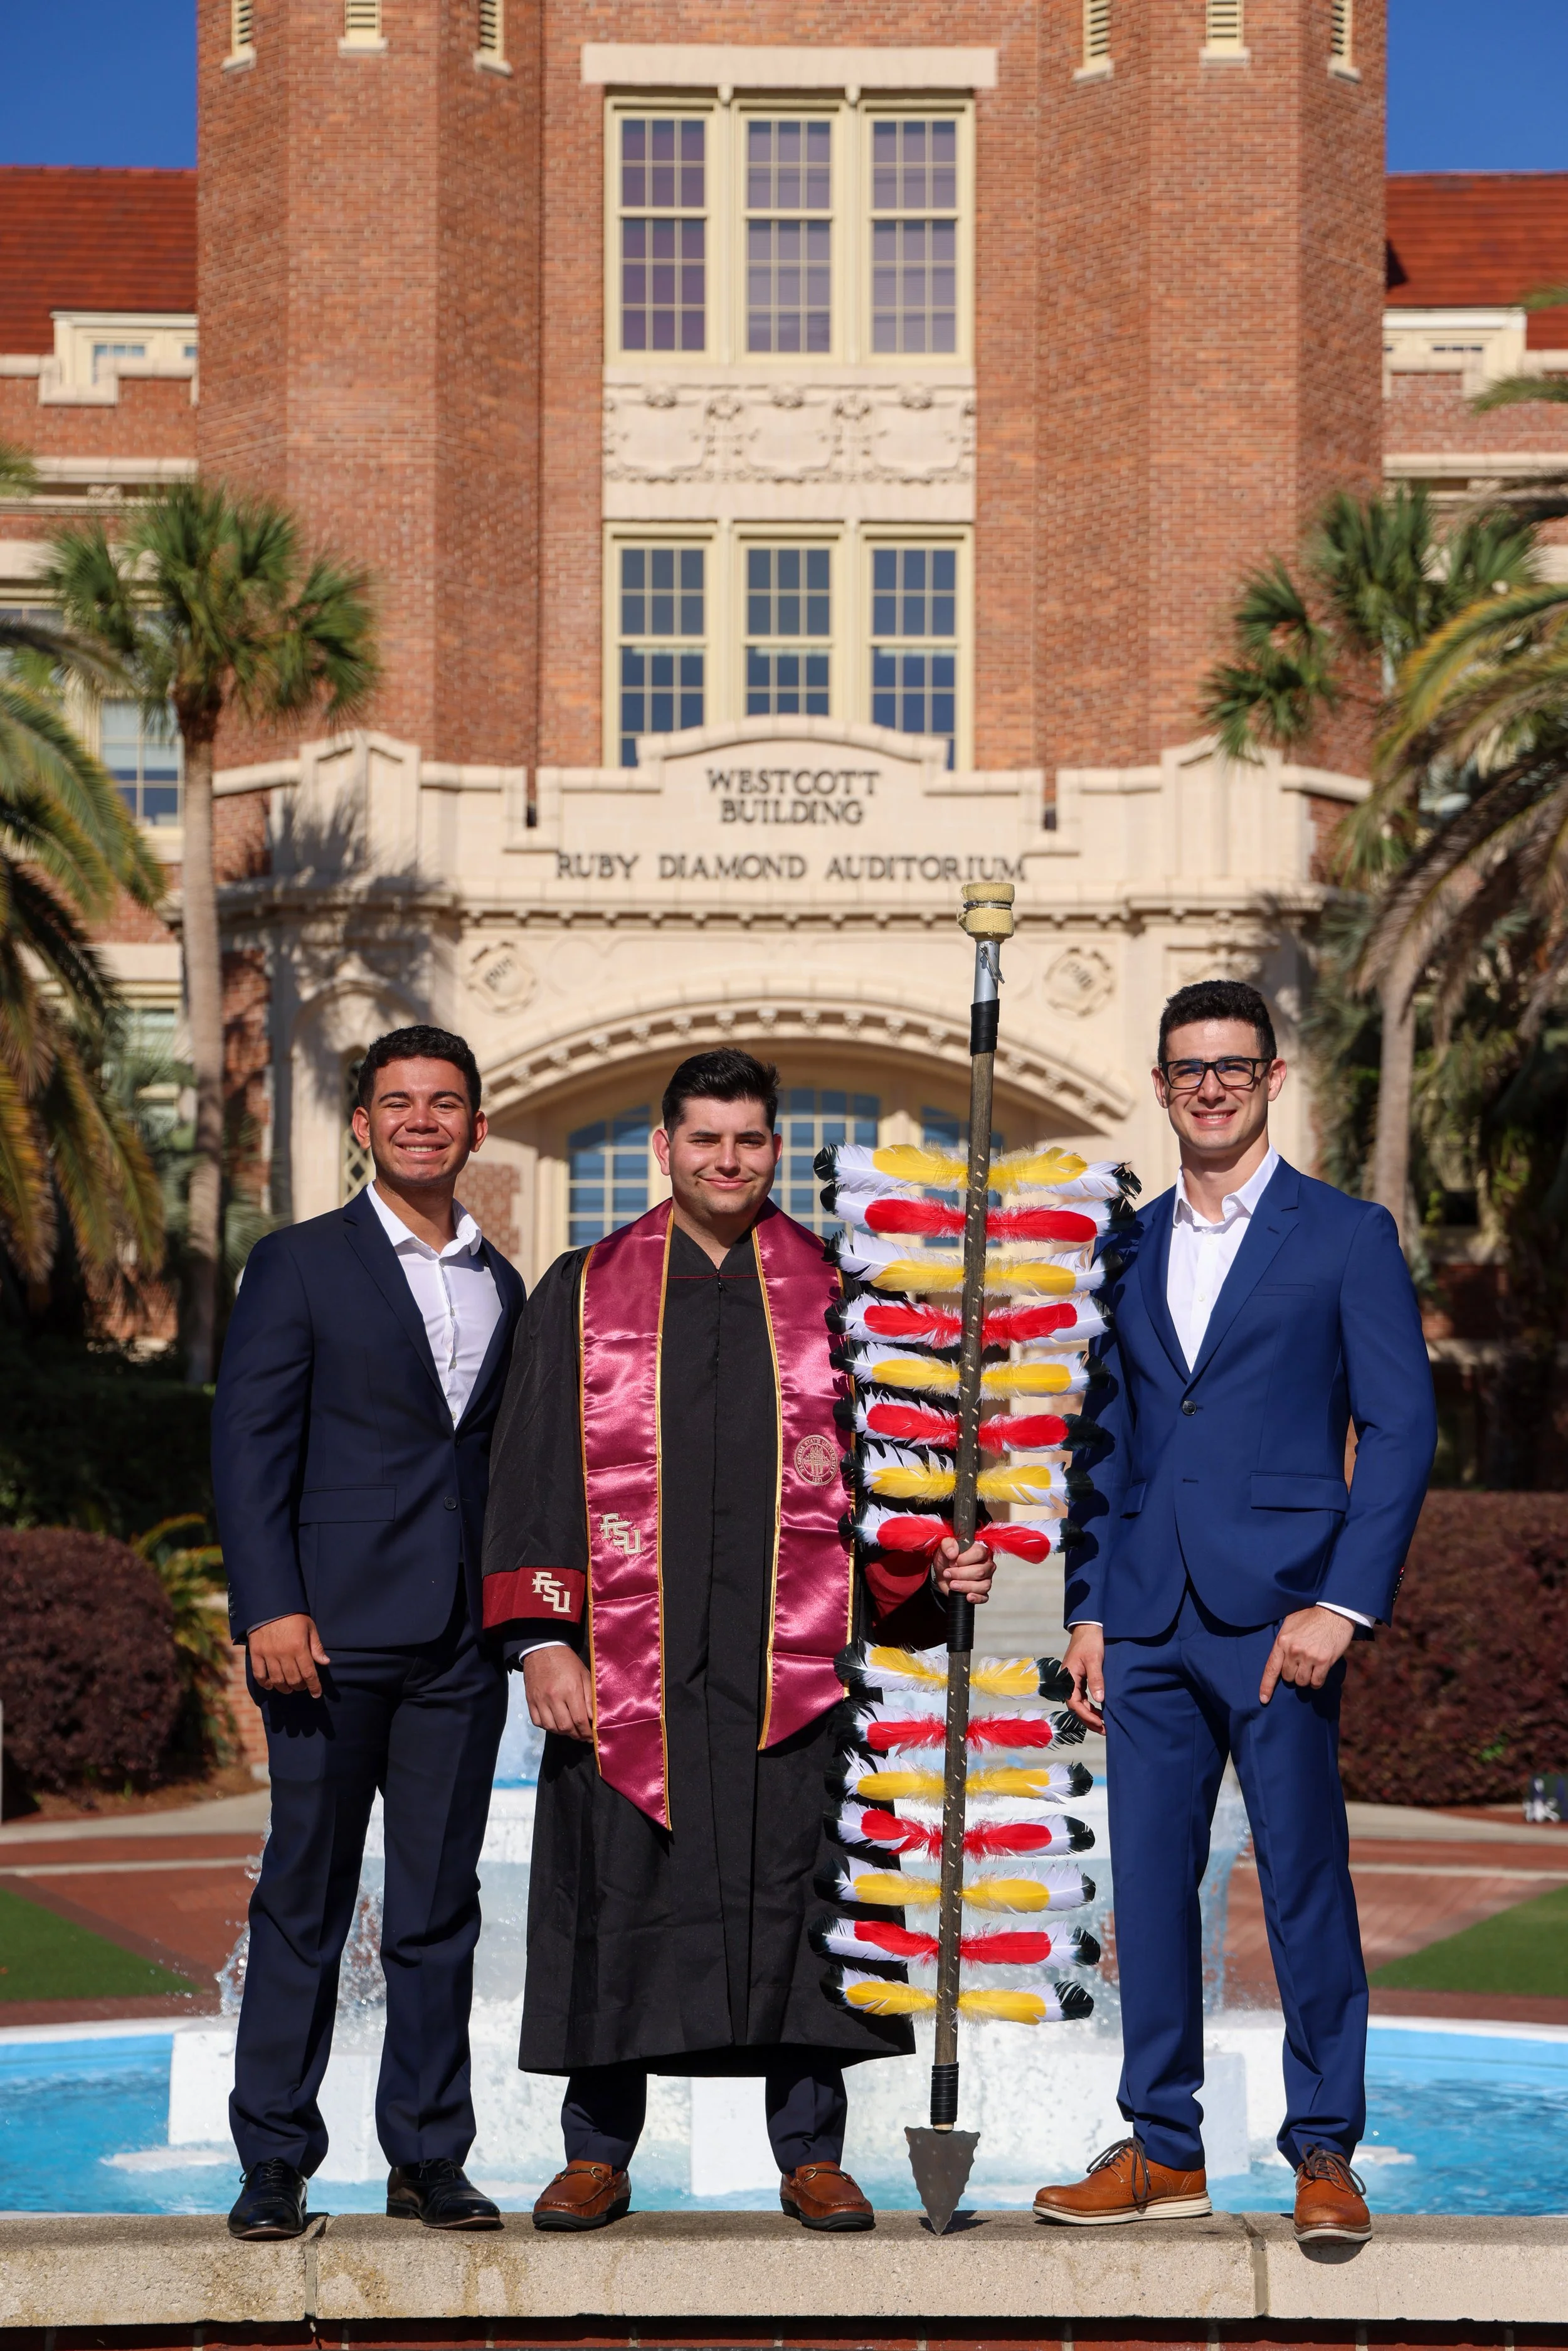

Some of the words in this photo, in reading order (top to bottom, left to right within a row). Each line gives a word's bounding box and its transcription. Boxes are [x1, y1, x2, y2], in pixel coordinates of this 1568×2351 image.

[706, 768, 879, 795] WESTCOTT
[720, 799, 863, 825] BUILDING
[556, 852, 638, 879] RUBY
[658, 853, 807, 880] DIAMOND
[824, 854, 1027, 881] AUDITORIUM
[822, 1440, 836, 1474] UNIVERSITY
[600, 1513, 643, 1554] FSU
[532, 1571, 571, 1613] FSU
